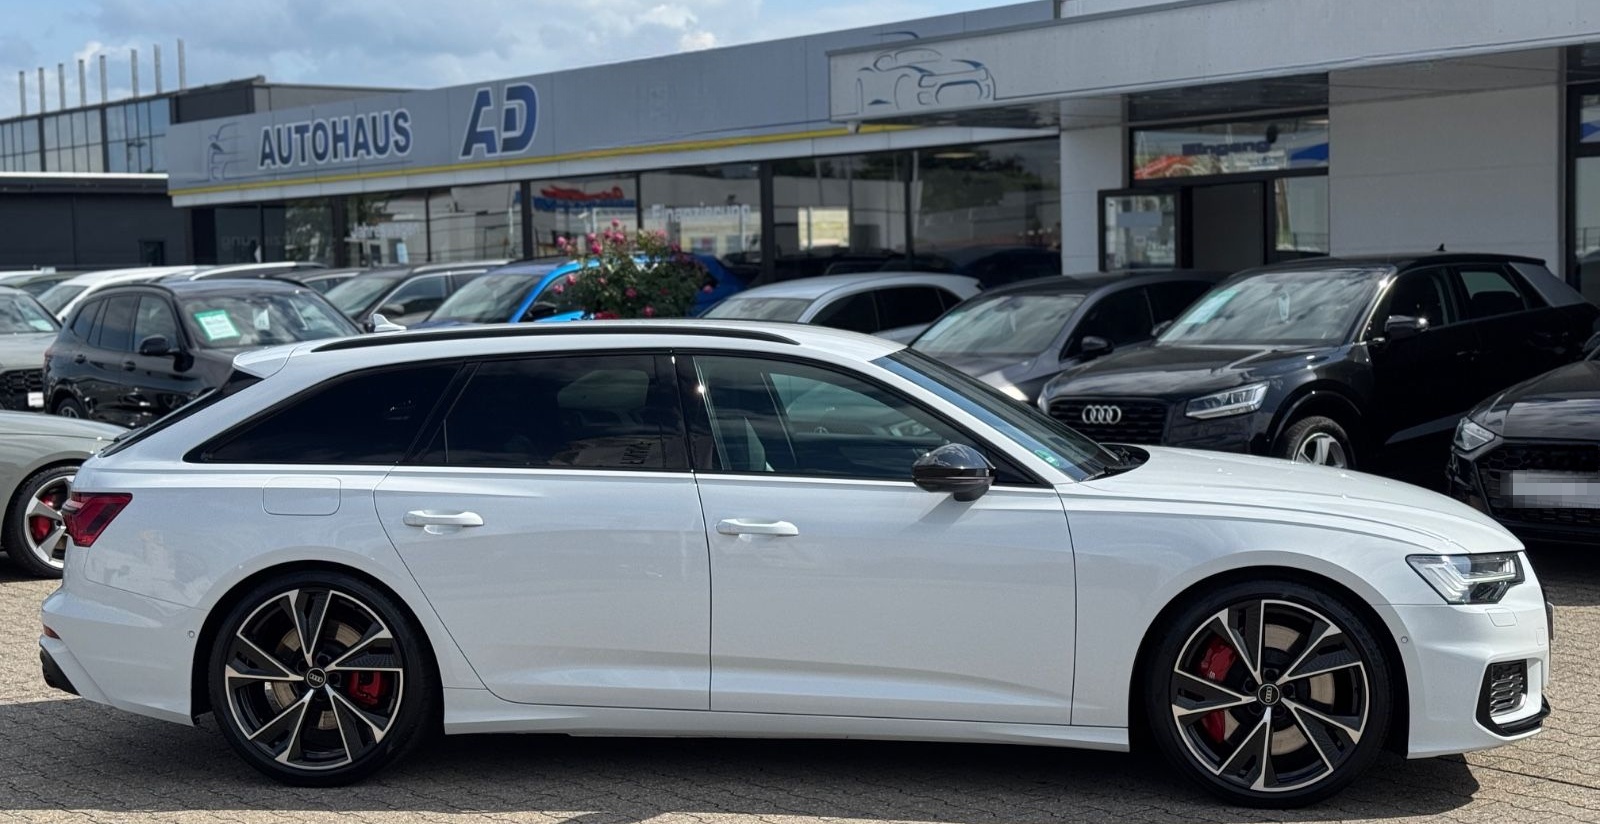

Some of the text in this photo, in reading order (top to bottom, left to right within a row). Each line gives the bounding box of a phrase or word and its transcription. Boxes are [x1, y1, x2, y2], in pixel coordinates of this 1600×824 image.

[258, 83, 538, 168] AUTOHAUS AD
[651, 202, 750, 221] Finanzierung
